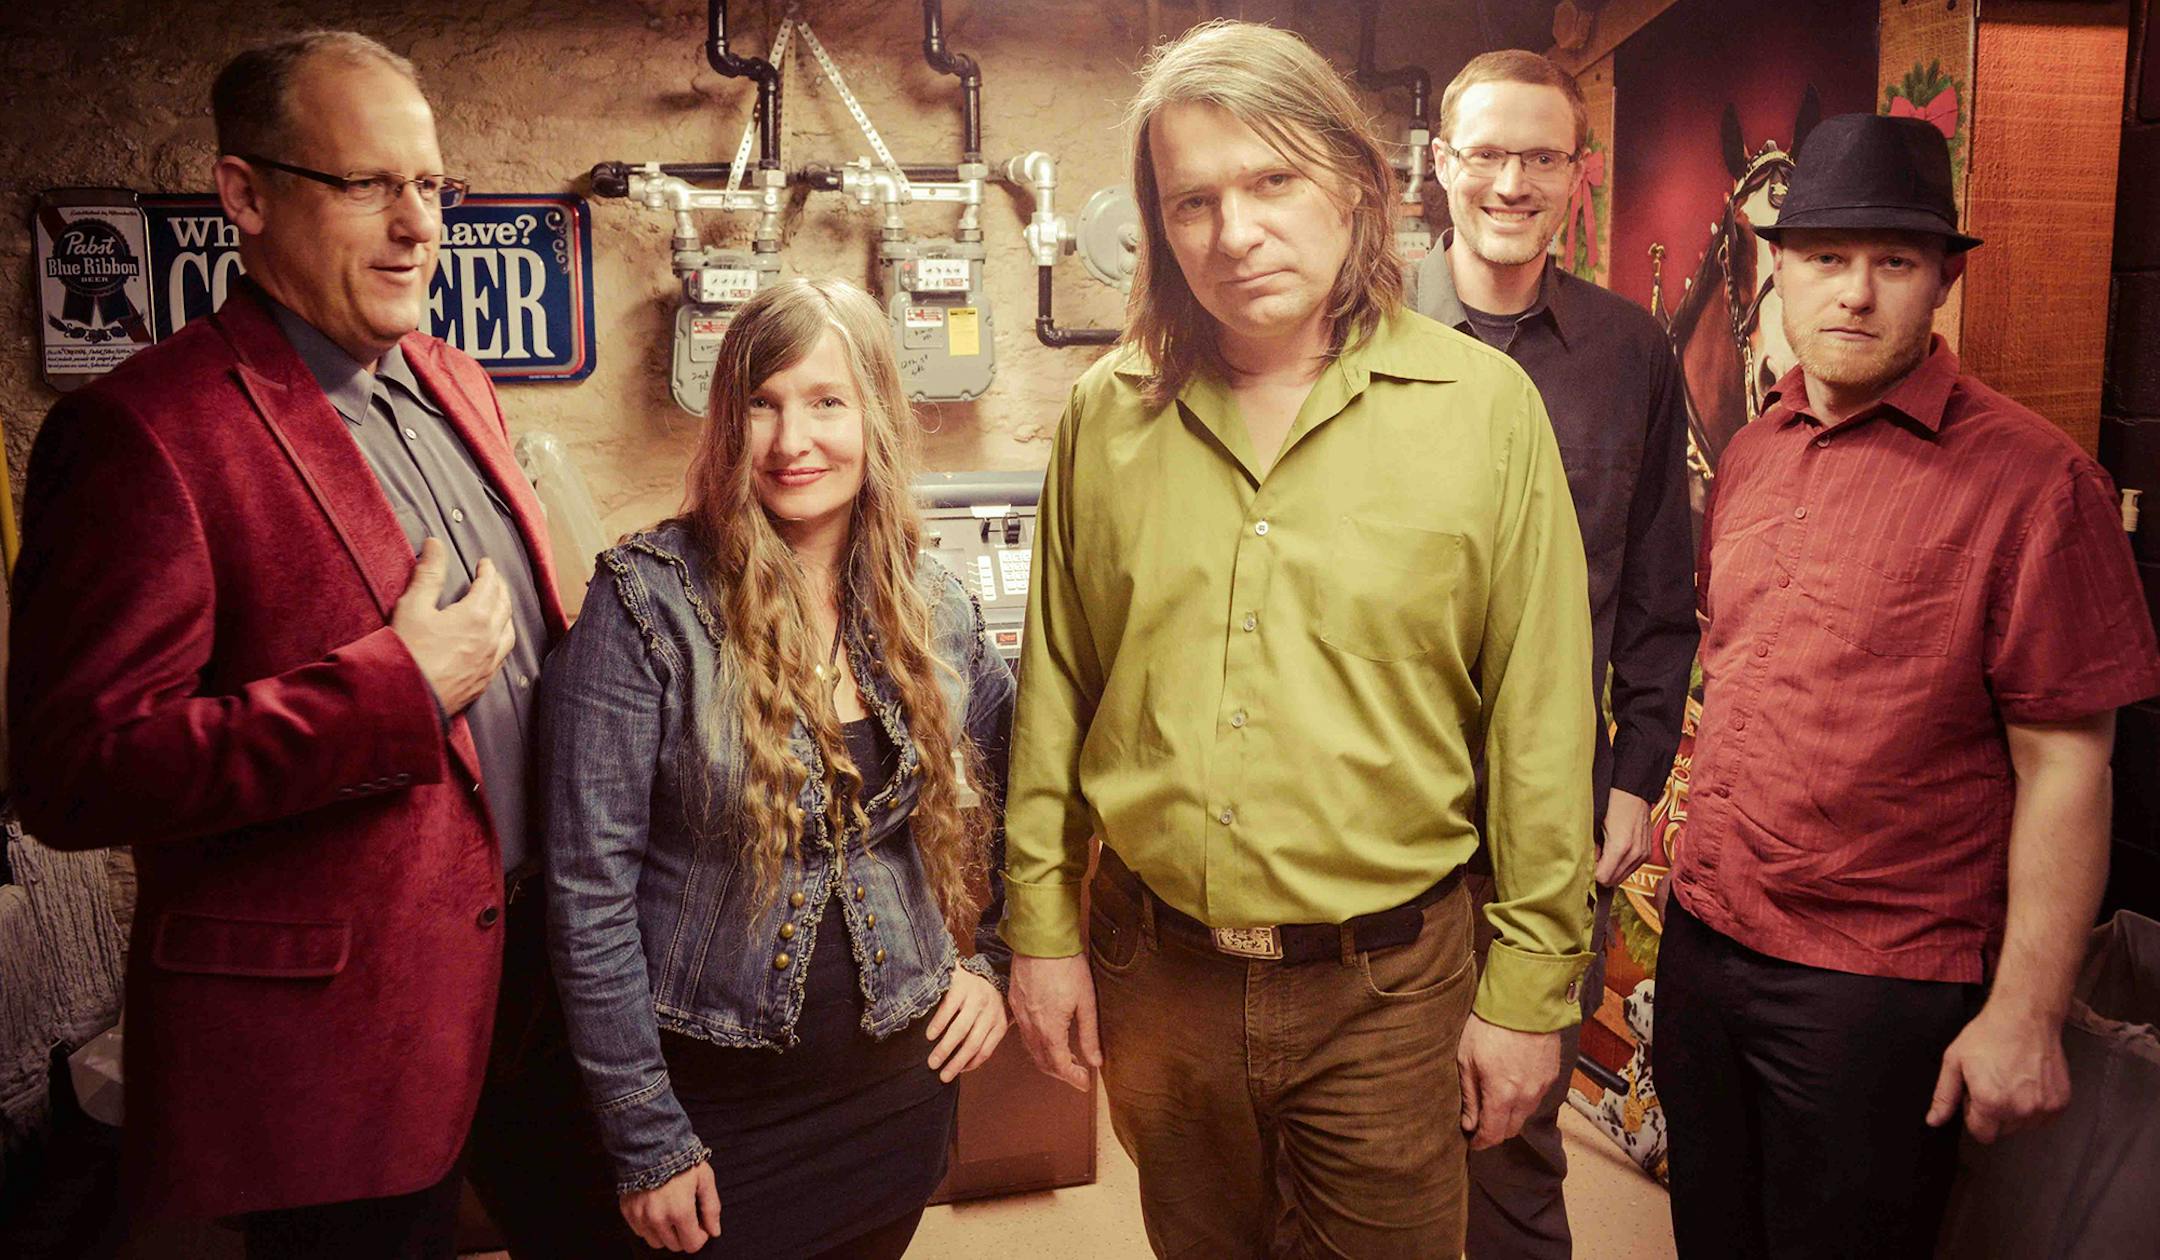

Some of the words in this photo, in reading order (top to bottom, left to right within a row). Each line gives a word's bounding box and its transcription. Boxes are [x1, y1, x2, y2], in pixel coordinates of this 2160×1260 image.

[64, 231, 117, 255] Pabst
[48, 259, 81, 276] Blue
[83, 257, 138, 275] Ribbon
